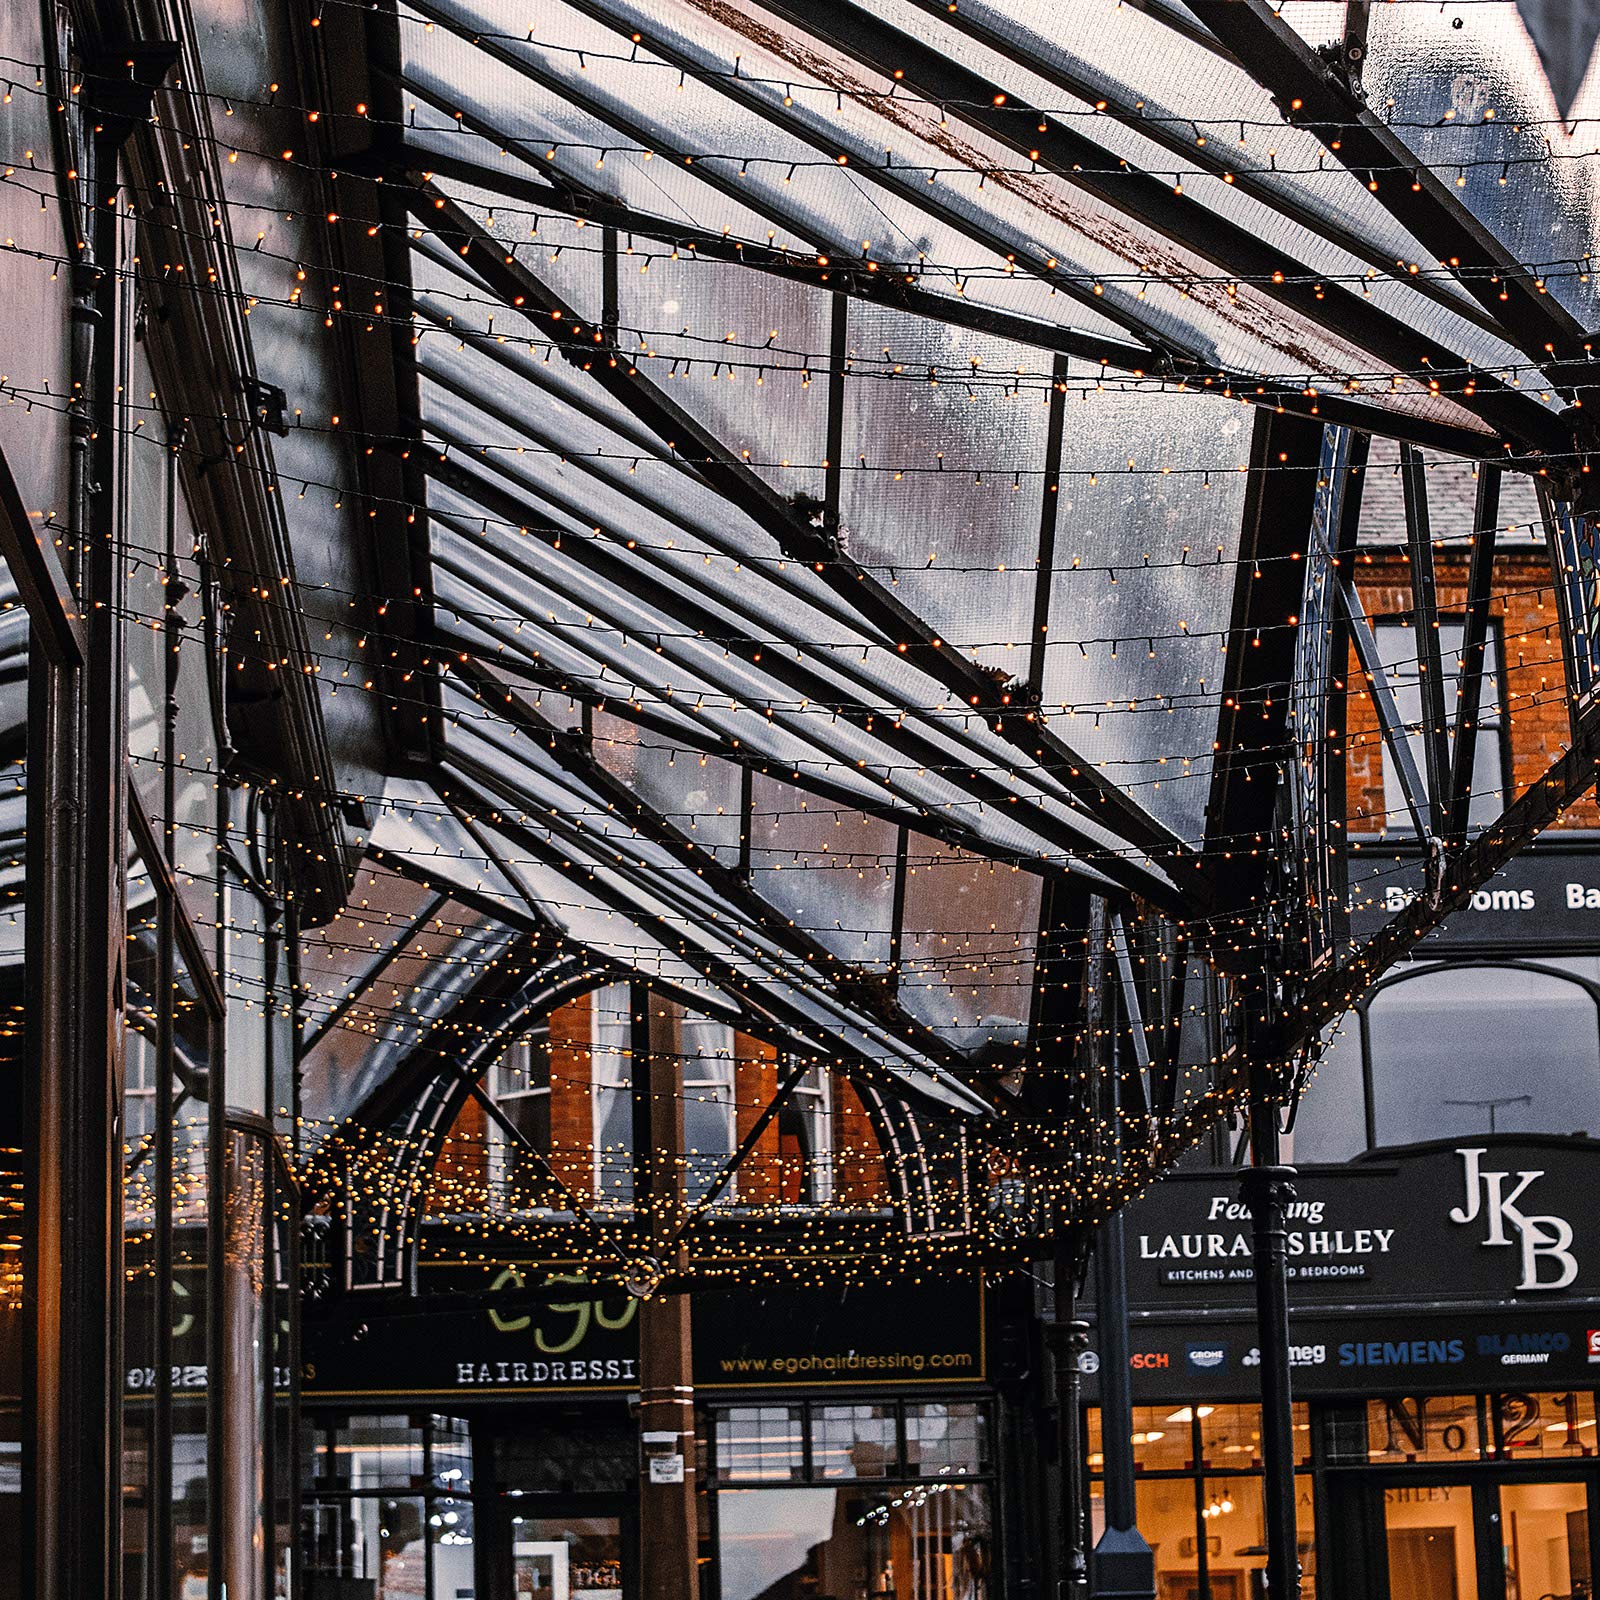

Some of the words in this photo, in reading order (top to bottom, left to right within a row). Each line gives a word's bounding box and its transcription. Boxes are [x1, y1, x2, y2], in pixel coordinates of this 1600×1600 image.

[1208, 1197, 1325, 1225] Feaing
[1450, 1148, 1579, 1290] JKB
[1139, 1233, 1252, 1259] LAURA
[1287, 1229, 1395, 1256] SHLEY
[1167, 1269, 1224, 1281] KITCHENS
[1228, 1269, 1254, 1279] AND
[1301, 1265, 1365, 1277] BEDROOMS
[1338, 1339, 1466, 1367] SIEMENS
[1478, 1332, 1570, 1354] BLANCO
[456, 1359, 636, 1384] HAIRDRESSI
[720, 1353, 973, 1374] www.egohairdressing.com
[1501, 1353, 1550, 1365] GERMANY
